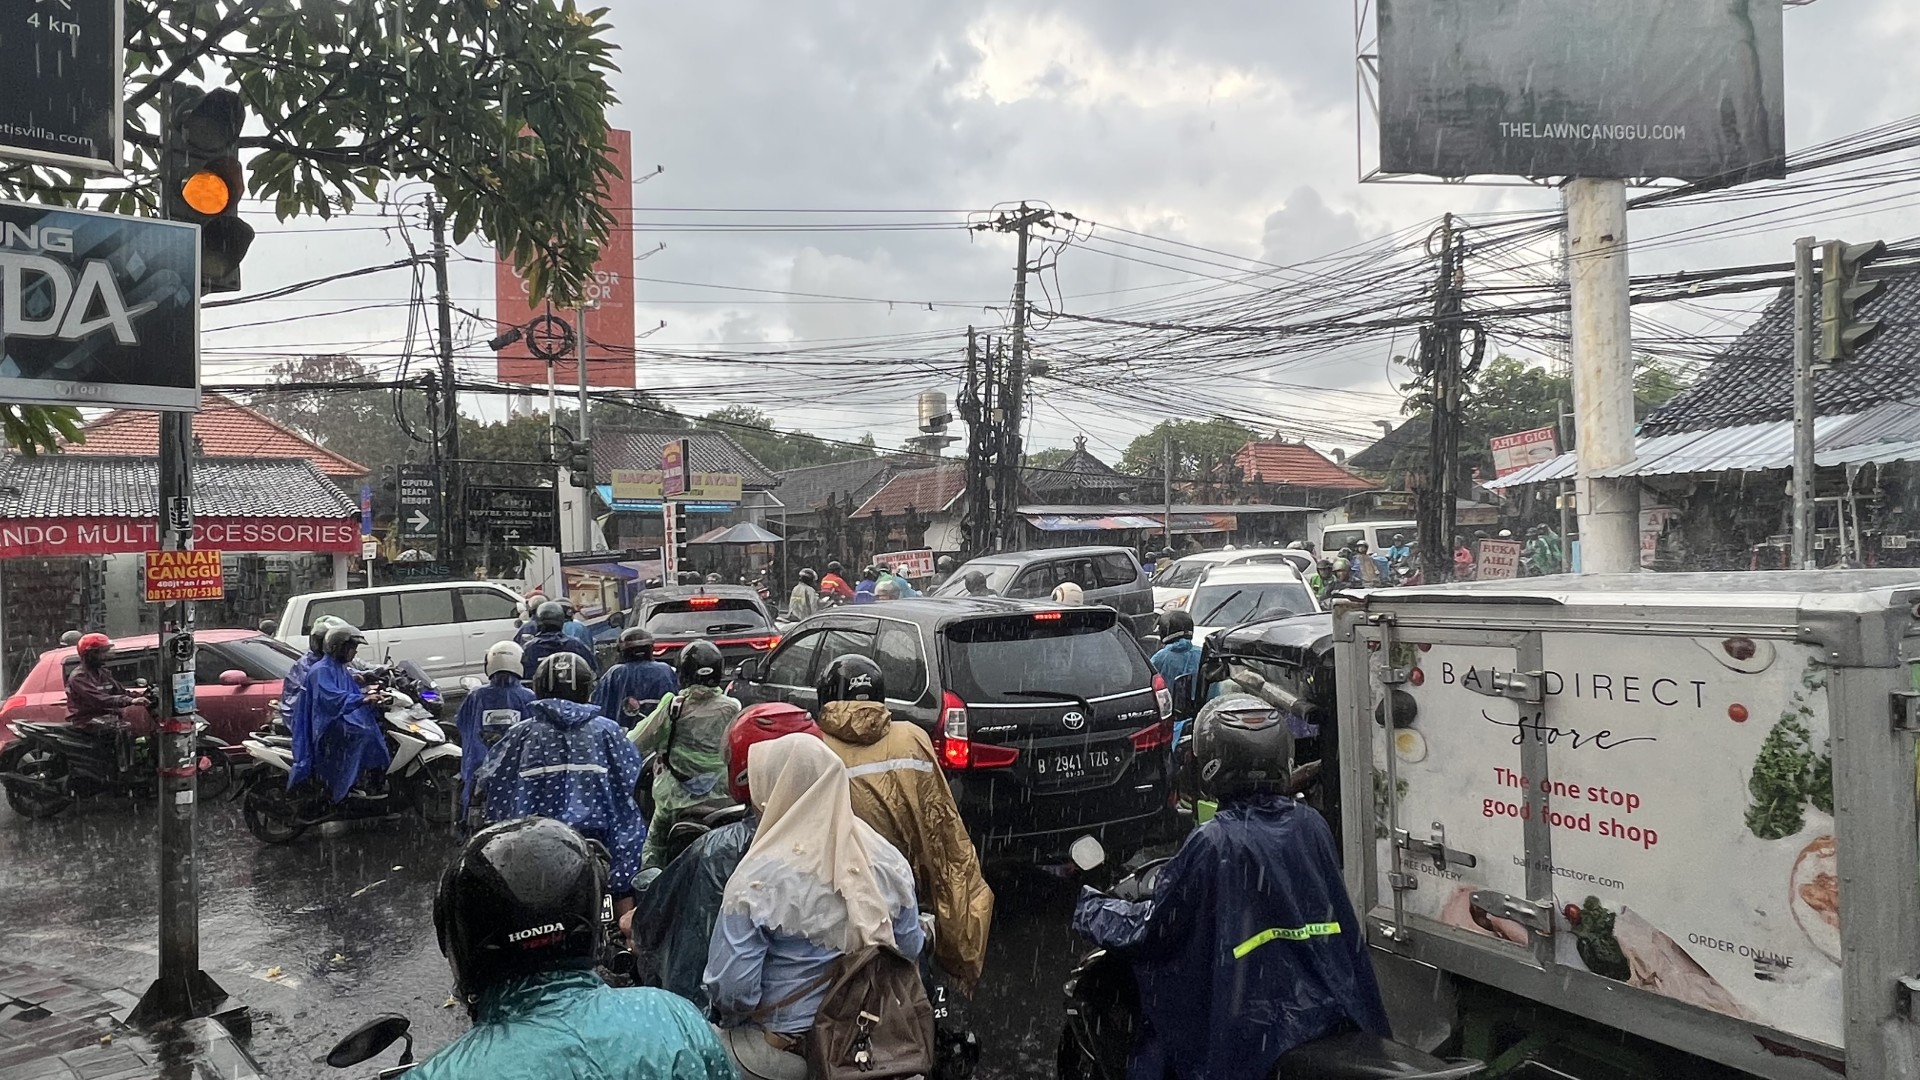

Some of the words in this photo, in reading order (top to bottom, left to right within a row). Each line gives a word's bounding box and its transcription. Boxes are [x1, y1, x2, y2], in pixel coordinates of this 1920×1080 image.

[26, 12, 41, 28] 4
[49, 15, 81, 36] km
[1499, 122, 1686, 140] THELAWNCANGGU.COM
[0, 221, 74, 253] NG
[401, 479, 434, 488] CIPUTRA
[401, 488, 428, 497] BEACH
[469, 510, 503, 518] HOTEL
[0, 525, 68, 547] NDO
[77, 524, 159, 545] MULTI
[192, 524, 353, 544] CCESSORIES
[147, 551, 220, 566] TANAH
[1483, 556, 1514, 567] AHLI
[147, 565, 221, 580] CANGGU
[398, 566, 451, 576] FINNS
[1544, 670, 1707, 709] DIRECT
[1481, 709, 1657, 750] store
[1037, 758, 1046, 774] B
[1054, 754, 1082, 772] 2941
[1089, 751, 1109, 768] TZG
[1493, 767, 1531, 790] The
[1540, 778, 1581, 799] one
[1587, 785, 1641, 813] stop
[1482, 798, 1531, 821] good
[1540, 806, 1591, 833] food
[1598, 817, 1658, 850] shop
[508, 922, 565, 942] HONDA
[1688, 932, 1735, 953] ORDER
[936, 986, 946, 1002] Z
[934, 1007, 948, 1019] 25
